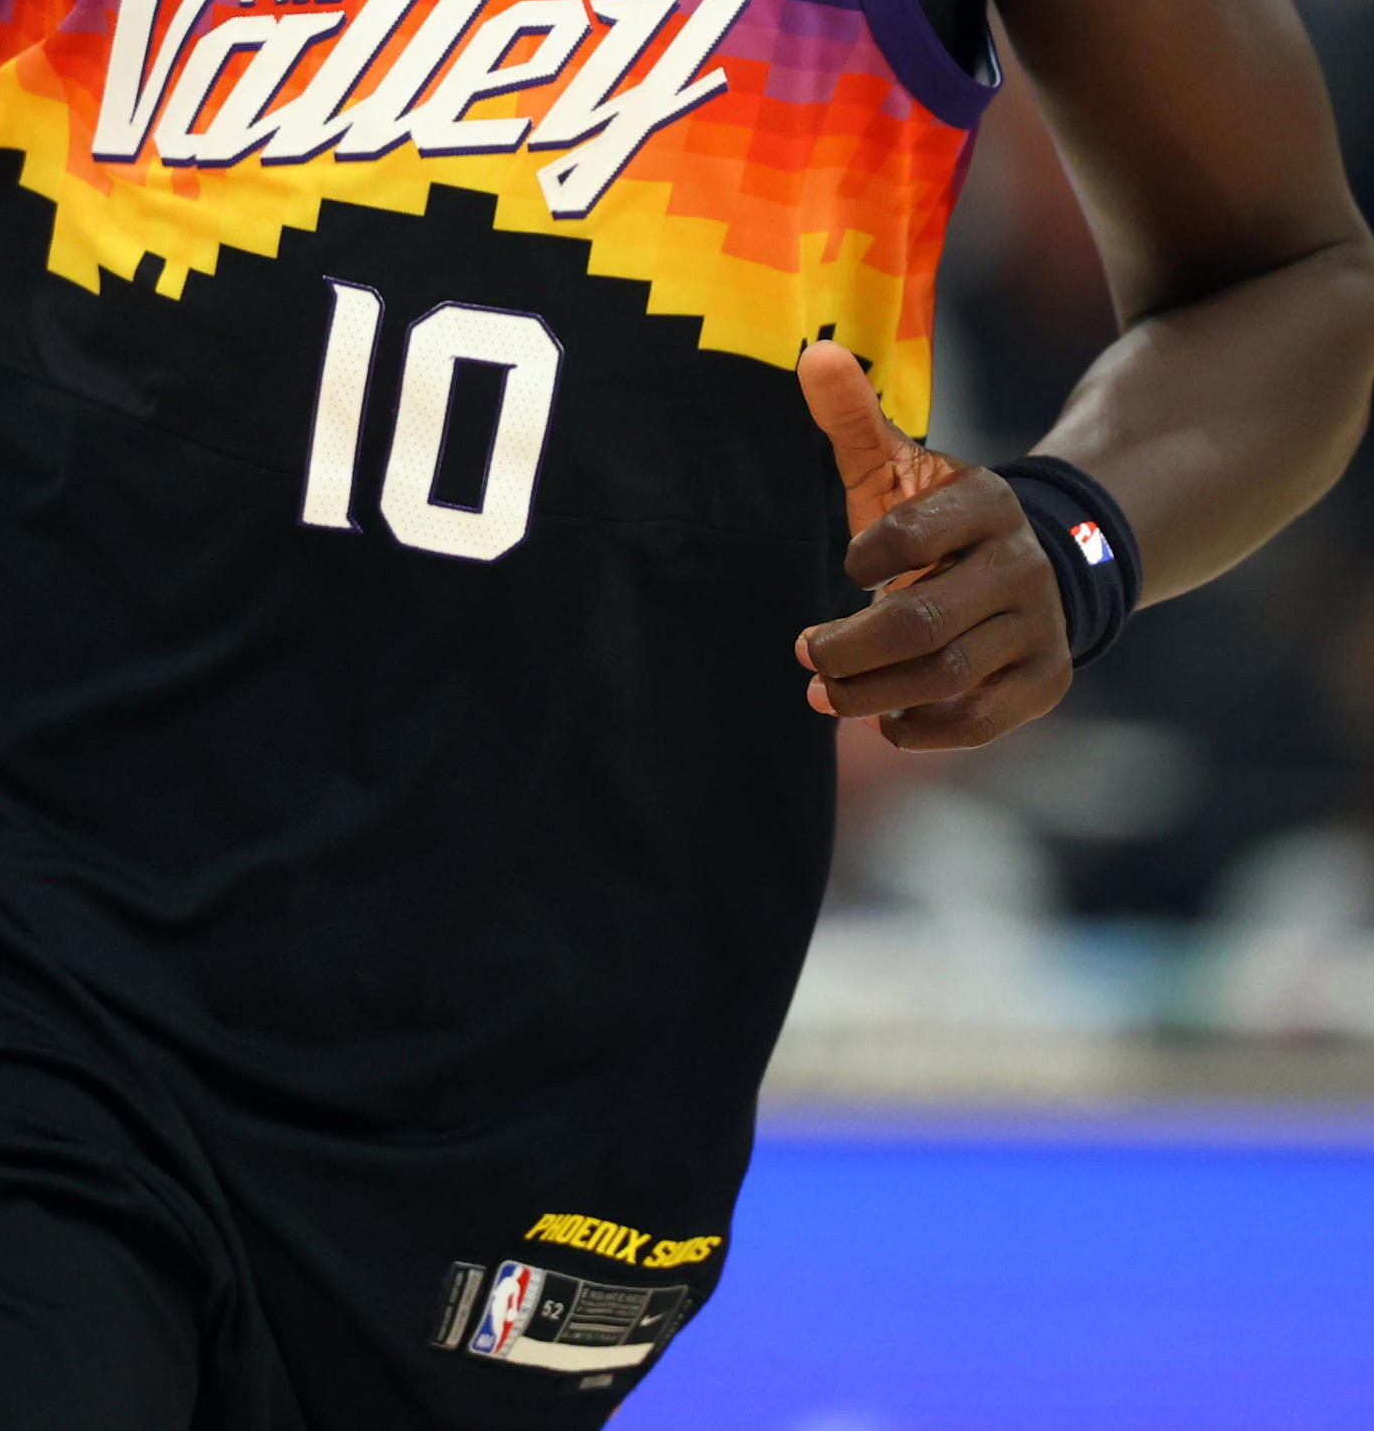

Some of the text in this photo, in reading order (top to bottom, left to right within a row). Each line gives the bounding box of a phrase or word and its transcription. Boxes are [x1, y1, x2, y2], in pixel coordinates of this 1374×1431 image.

[298, 274, 564, 562] 10
[525, 1213, 652, 1265] PHOENIX
[541, 1300, 564, 1320] 52
